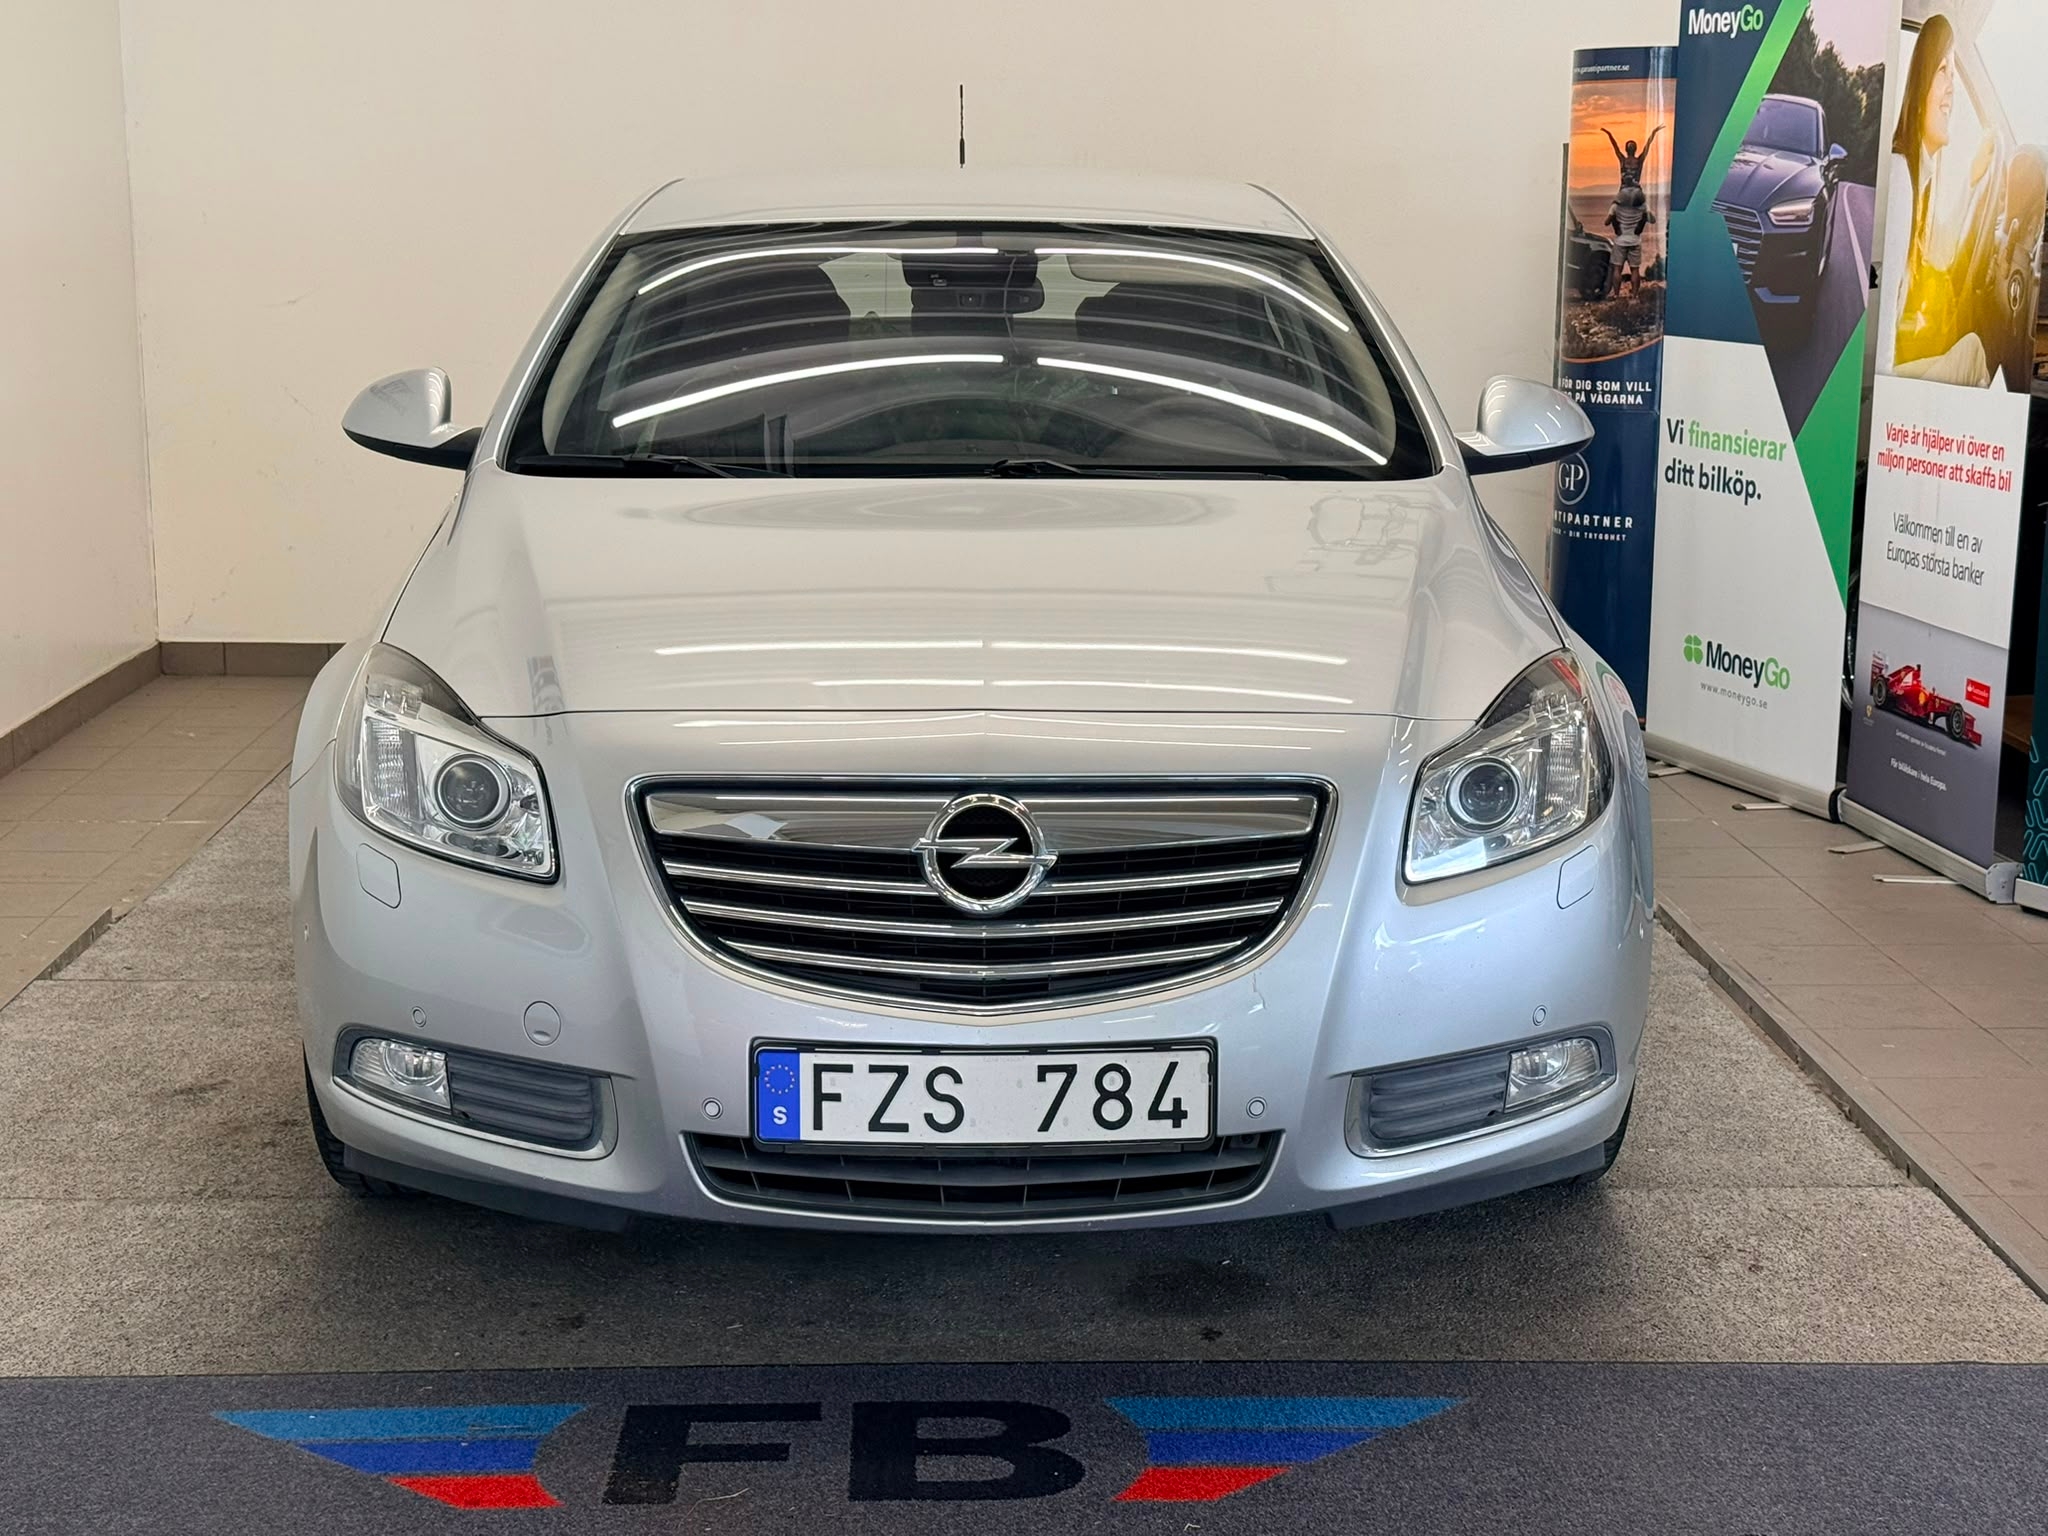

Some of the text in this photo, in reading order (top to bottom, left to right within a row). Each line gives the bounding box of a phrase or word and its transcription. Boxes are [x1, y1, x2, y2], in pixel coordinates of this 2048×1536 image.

[1688, 4, 1764, 39] MoneyGo
[1575, 379, 1592, 391] DIG
[1596, 380, 1620, 392] SOM
[1626, 381, 1652, 392] VILL
[1575, 391, 1586, 403] PÅ
[1590, 391, 1643, 405] VÄGARNA
[1666, 418, 1787, 462] Vi finansierar
[1886, 422, 2005, 463] Varje år hjälper vi över en
[1558, 462, 1584, 492] GP
[1664, 457, 1762, 506] ditt bilköp.
[1877, 447, 2013, 493] miljon personer att skaffa bil
[1893, 512, 1983, 554] Välkommen till en av
[1886, 540, 1985, 586] Europas största banker
[1705, 640, 1791, 690] MoneyGo
[1700, 681, 1768, 710] www.moneygo.se
[772, 1105, 789, 1126] S
[811, 1060, 1189, 1134] FZS 784
